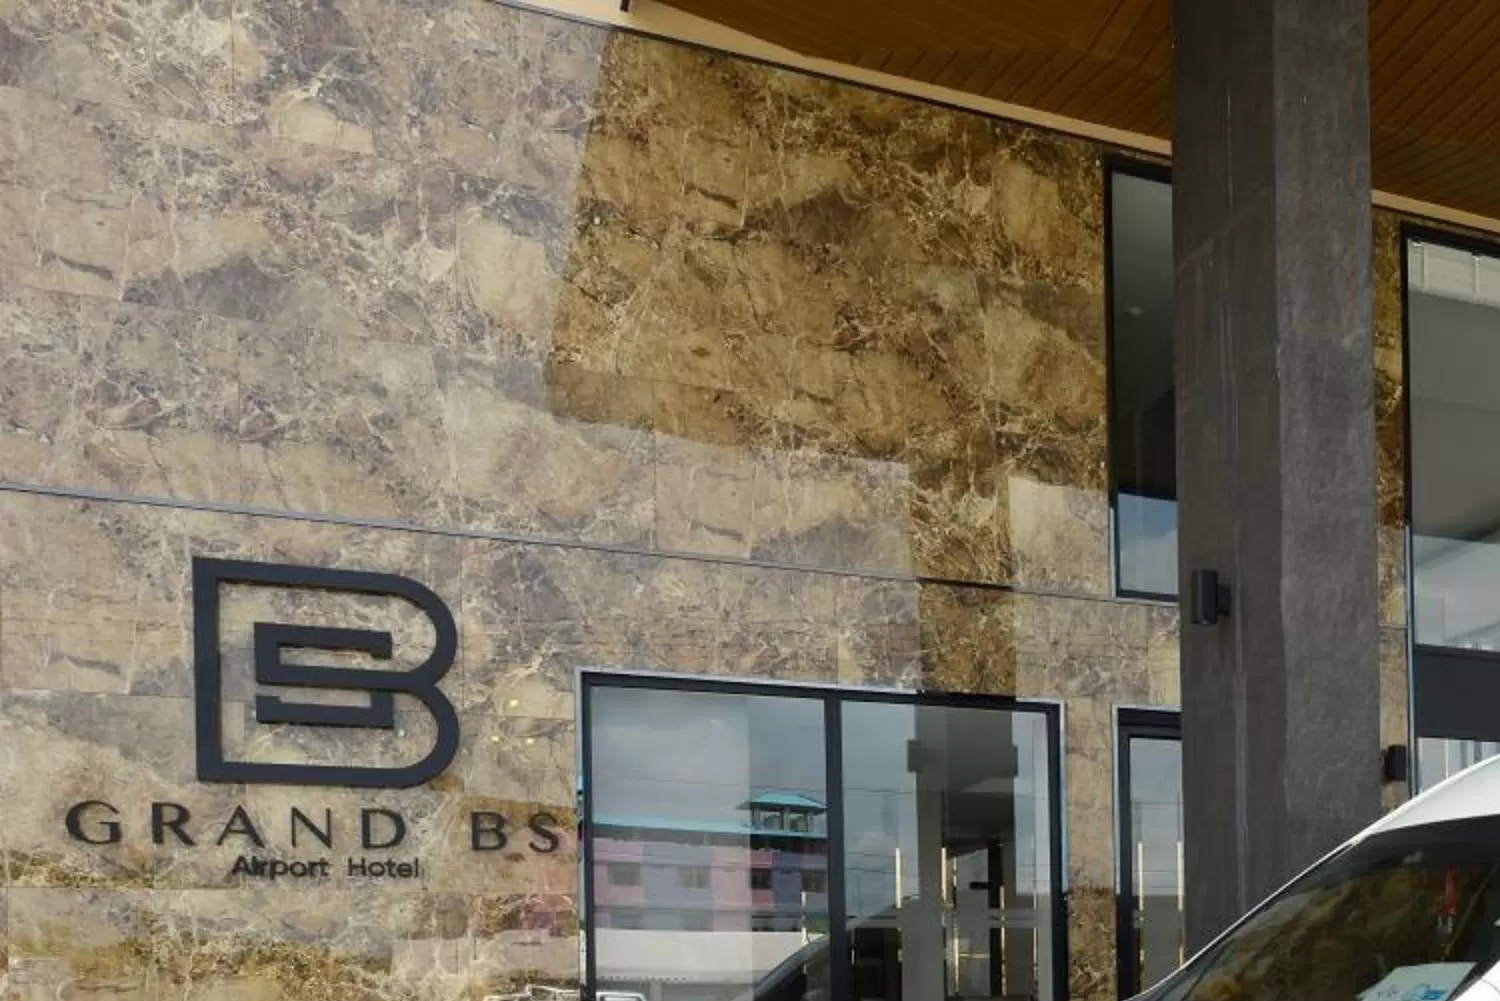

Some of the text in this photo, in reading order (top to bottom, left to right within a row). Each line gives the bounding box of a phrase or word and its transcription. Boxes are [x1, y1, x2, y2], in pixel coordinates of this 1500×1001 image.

[65, 800, 560, 853] GRAND BS
[232, 855, 420, 879] Airport Hotel
